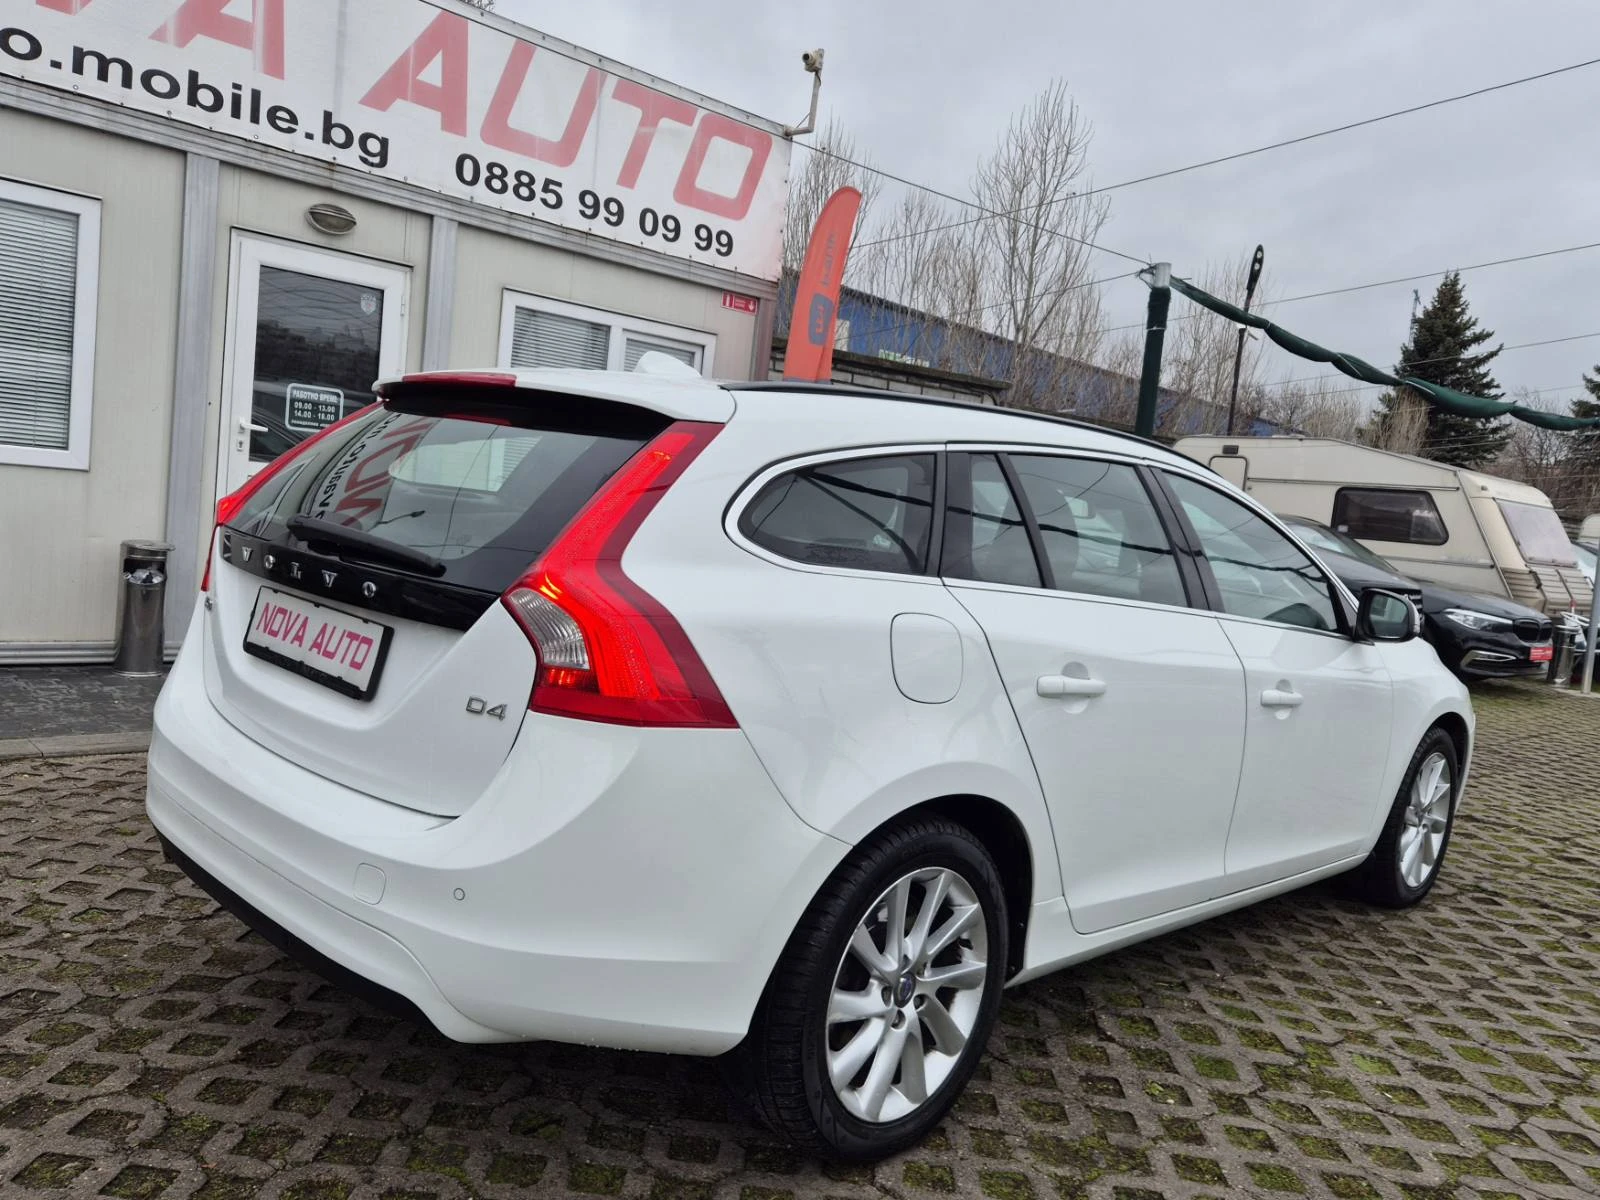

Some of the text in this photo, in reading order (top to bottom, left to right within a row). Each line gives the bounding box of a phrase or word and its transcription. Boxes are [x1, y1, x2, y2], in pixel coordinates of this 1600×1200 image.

[0, 27, 390, 169] o.mobile.bg
[357, 9, 773, 222] AUTO
[455, 153, 734, 258] 0885 99 09 99
[294, 401, 312, 410] 09.00
[318, 404, 335, 413] 13.00
[294, 410, 312, 418] 14.00
[318, 412, 335, 421] 18.00
[241, 546, 377, 598] VOLVO
[256, 602, 309, 648] NOVA
[308, 622, 374, 671] AUTO
[466, 696, 507, 721] D4
